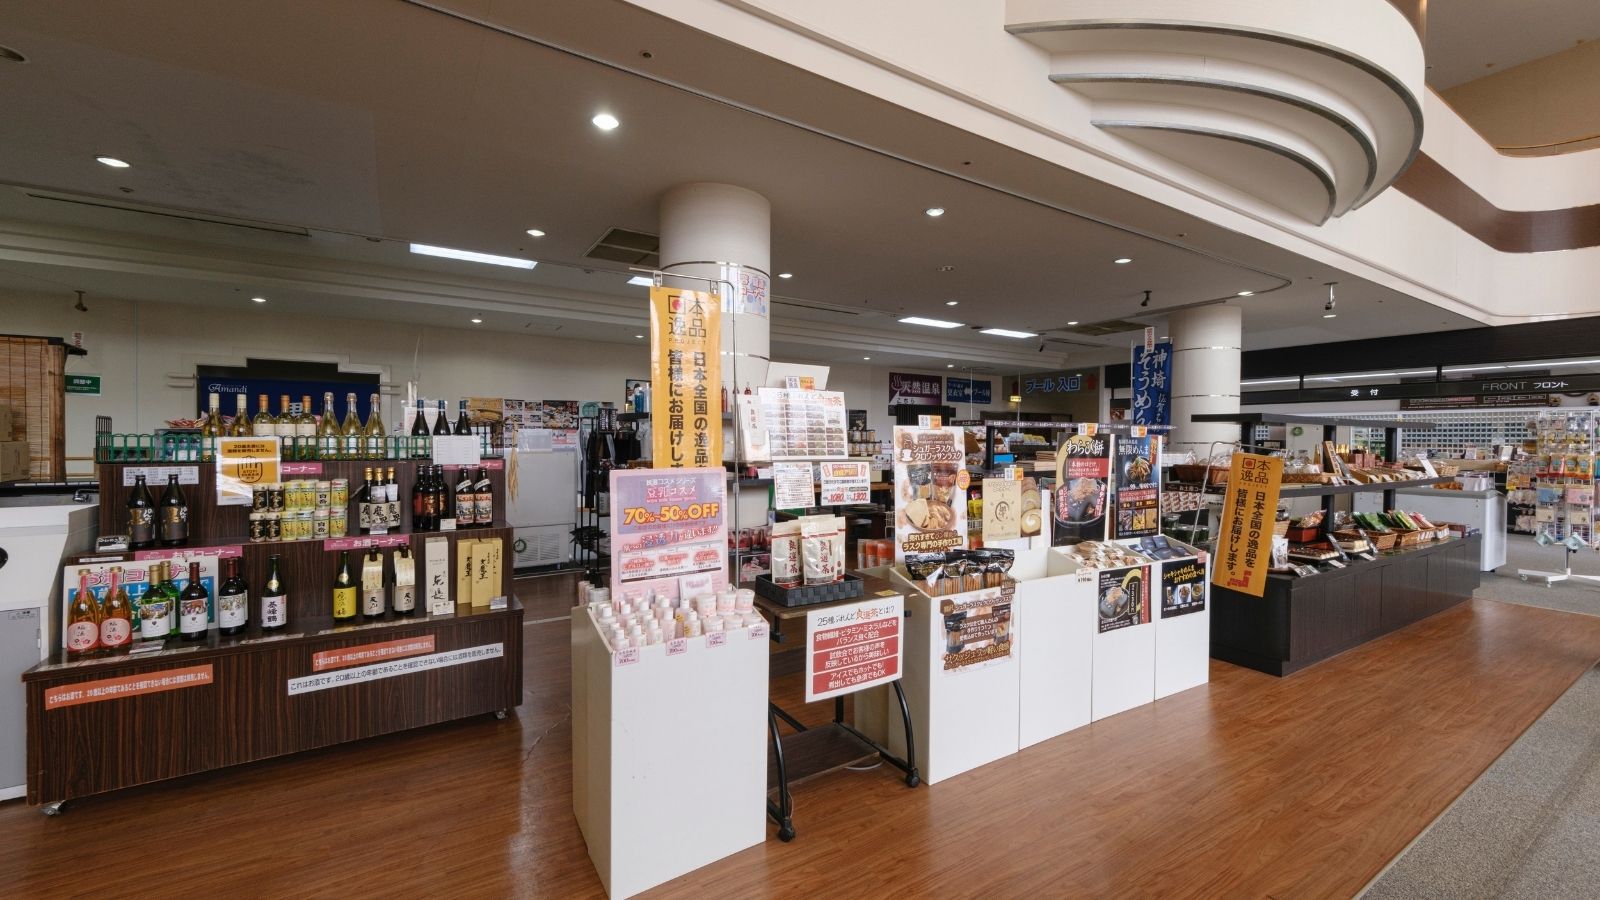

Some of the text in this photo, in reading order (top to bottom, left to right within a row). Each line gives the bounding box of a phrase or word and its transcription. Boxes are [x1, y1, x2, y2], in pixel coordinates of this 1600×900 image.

[208, 383, 248, 393] Amandi
[900, 380, 941, 395] 天然温泉
[1026, 376, 1081, 392] プール 入口
[1482, 381, 1569, 391] FRONT フロント
[1350, 388, 1378, 397] 受付
[668, 349, 684, 468] 皆様にお届けし
[693, 352, 708, 467] 日本全国の逸品
[1066, 439, 1104, 456] わらび餅
[1118, 444, 1149, 456] 無限めんま
[915, 452, 962, 460] クロワッサンラスク
[647, 486, 697, 498] 豆乳コスメ
[1227, 488, 1248, 576] 皆様にお届けします。
[1245, 491, 1266, 569] 日本全国の逸品を
[353, 538, 404, 547] お酒コーナー
[172, 549, 236, 560] お酒コーナー
